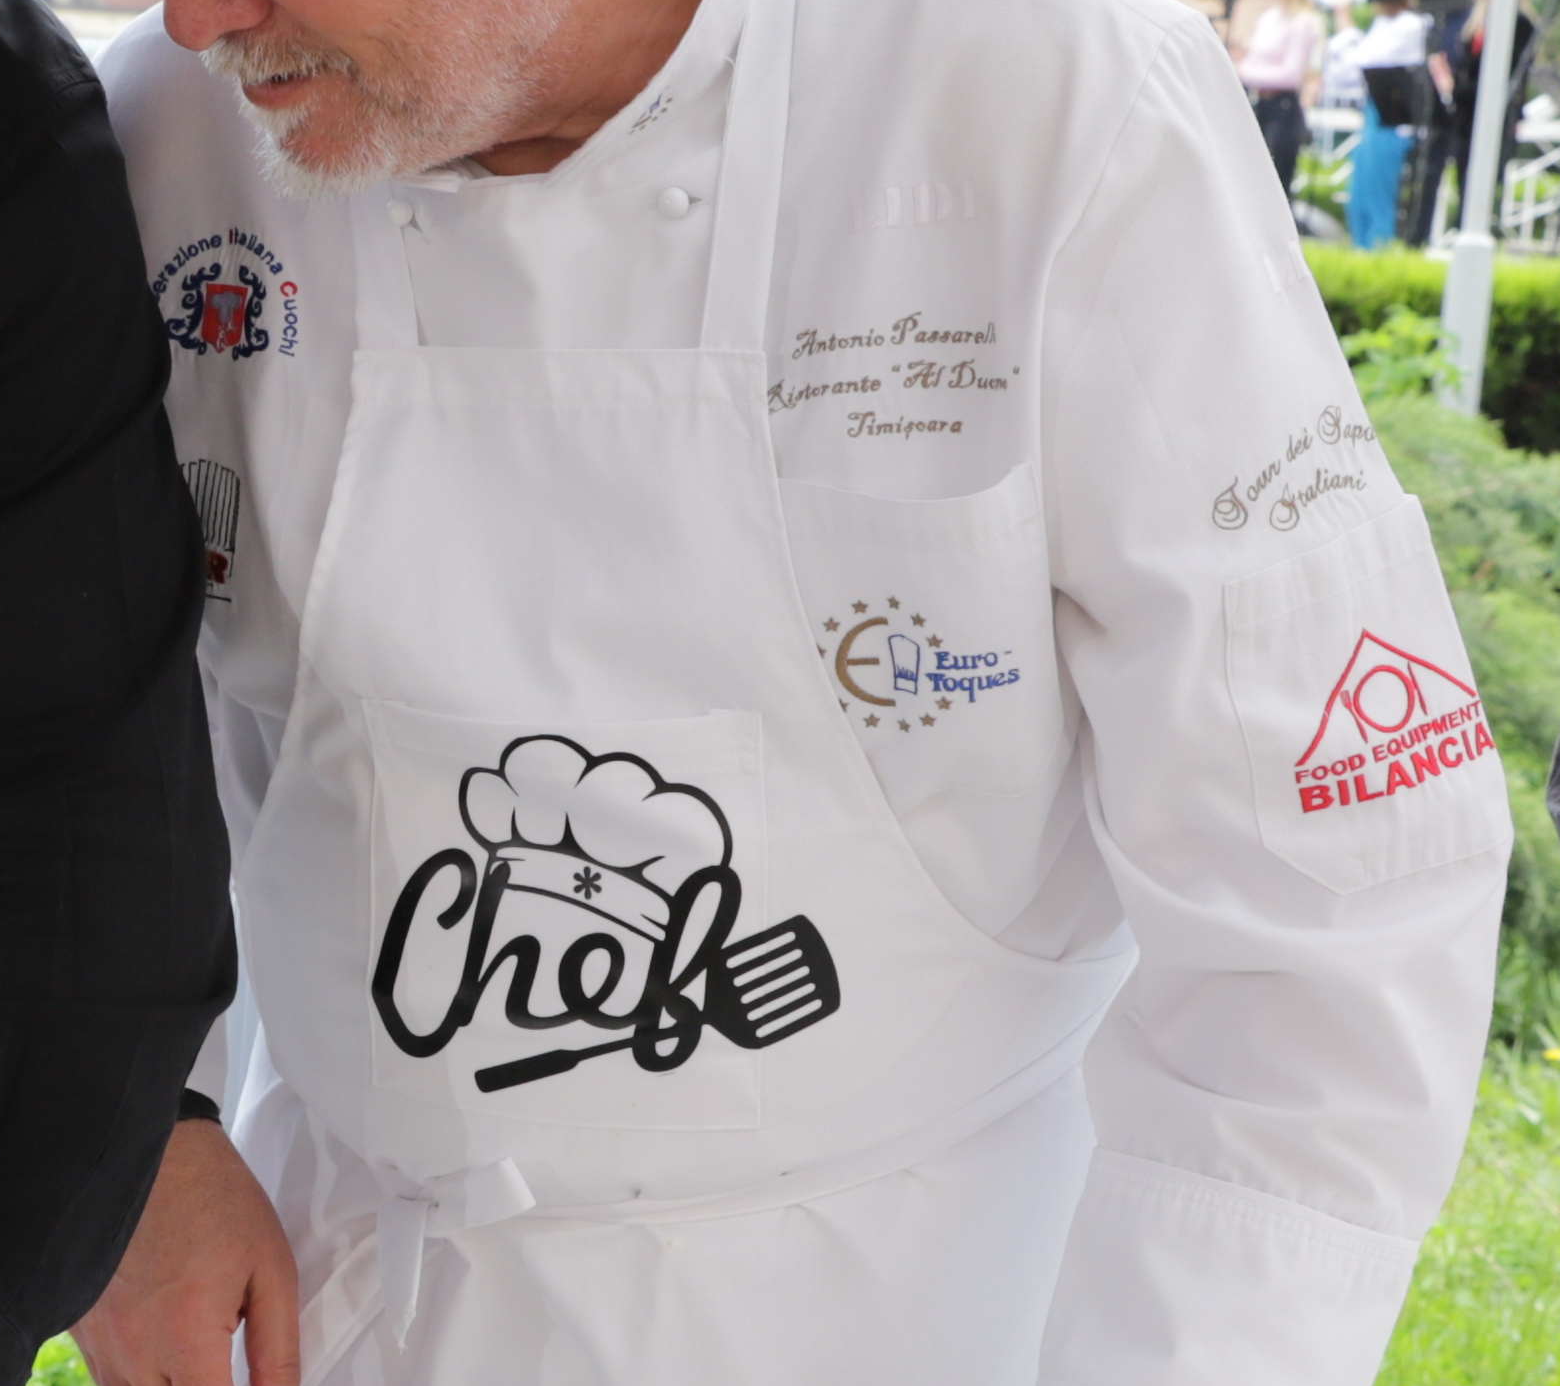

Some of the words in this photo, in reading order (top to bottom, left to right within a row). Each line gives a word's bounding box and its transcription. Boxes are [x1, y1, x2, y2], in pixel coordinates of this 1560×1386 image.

[792, 328, 885, 359] Antonio
[767, 376, 882, 412] Ristorante
[1286, 427, 1313, 463] dei
[925, 668, 1021, 703] Toques
[1295, 754, 1365, 783] FOOD
[1372, 700, 1484, 763] EQUIPMENT
[1299, 722, 1497, 813] BILANCIA
[372, 848, 742, 1072] Chef
